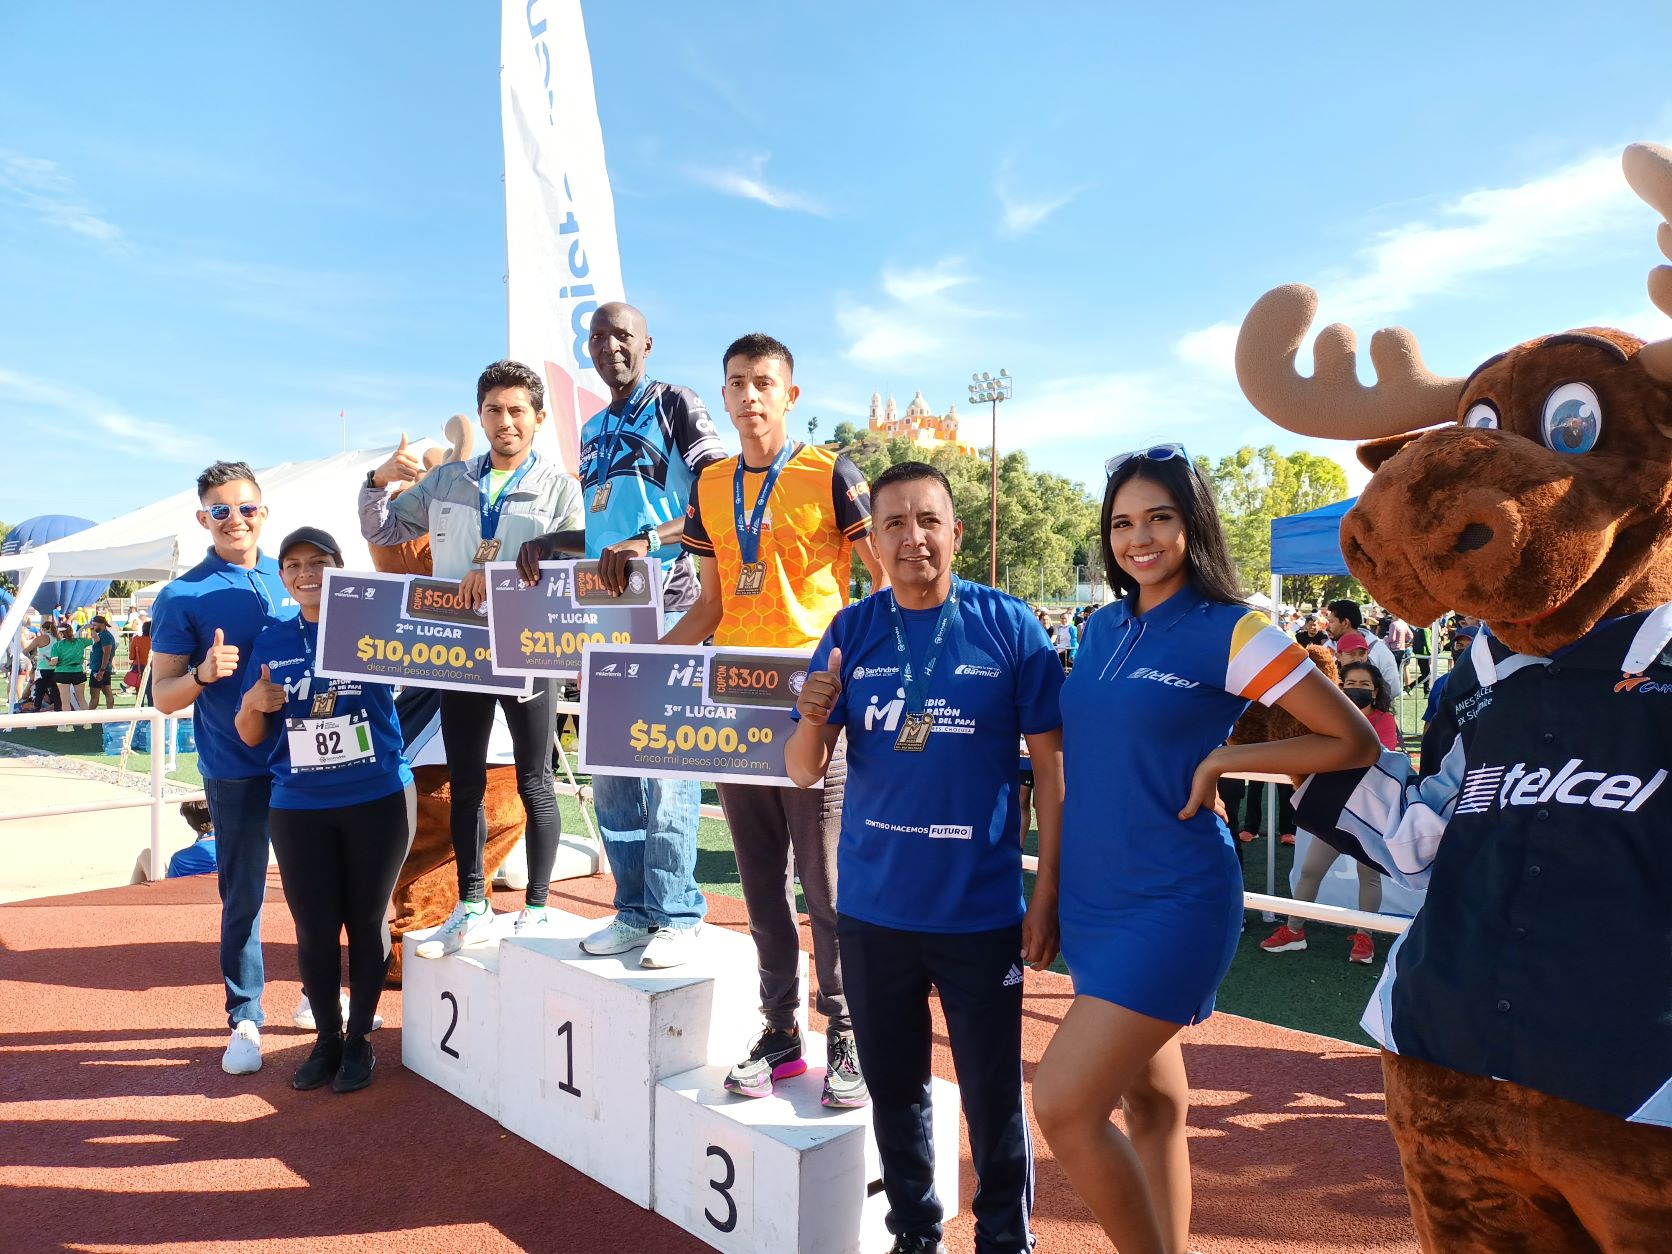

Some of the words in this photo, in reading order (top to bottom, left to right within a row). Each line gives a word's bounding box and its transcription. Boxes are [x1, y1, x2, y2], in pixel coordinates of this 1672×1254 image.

[561, 613, 598, 625] LUGAR
[396, 623, 414, 633] 2do
[417, 626, 462, 639] LUGAR
[367, 663, 385, 672] diez
[388, 665, 402, 673] mil
[404, 667, 430, 677] pesos
[432, 668, 462, 679] 00/100
[728, 666, 779, 689] $300
[1141, 670, 1201, 689] telcel
[664, 704, 682, 717] 3er
[685, 705, 737, 720] LUGAR
[938, 717, 952, 725] DEL
[954, 718, 976, 727] PAPÁ
[315, 731, 344, 756] 82
[634, 753, 661, 763] cinco
[663, 756, 680, 765] mil
[682, 757, 711, 766] pesos
[713, 757, 748, 769] 00/100
[750, 761, 772, 770] mn.
[1500, 759, 1669, 812] telcel
[890, 824, 929, 834] HACEMOS
[931, 827, 968, 836] FUTURO
[440, 990, 460, 1060] 2
[557, 1020, 582, 1098] 1
[704, 1145, 738, 1234] 3
